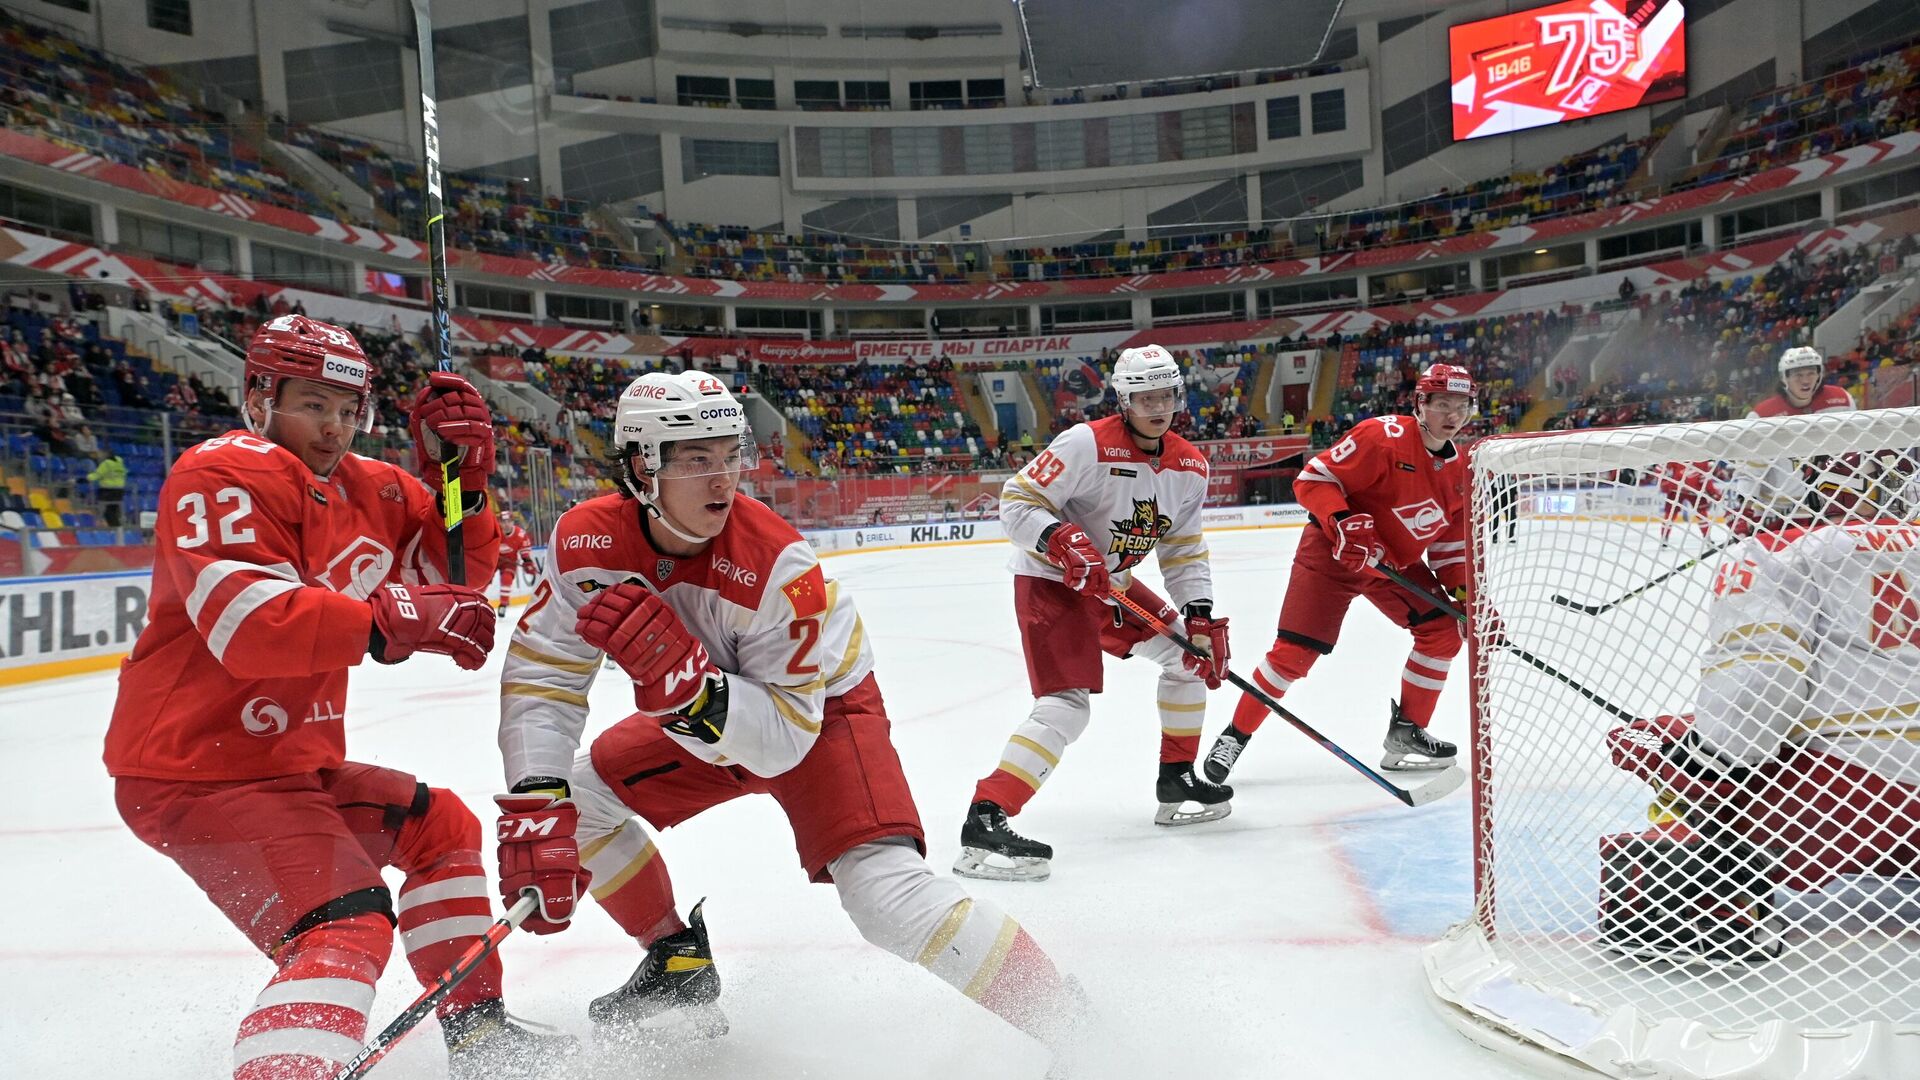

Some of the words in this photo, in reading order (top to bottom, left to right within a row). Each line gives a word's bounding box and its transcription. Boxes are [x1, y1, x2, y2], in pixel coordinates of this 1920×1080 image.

[1536, 12, 1627, 96] 75
[1488, 56, 1531, 83] 1946
[422, 93, 442, 200] CCM
[858, 343, 933, 357] ВМЕСТЕ
[941, 341, 975, 355] МЫ
[983, 336, 1071, 355] СПАРТАК
[1142, 350, 1160, 359] 93
[325, 361, 365, 379] согаз
[628, 384, 666, 400] vanke
[700, 408, 738, 420] согаз
[1103, 447, 1132, 459] vanke
[1026, 450, 1066, 489] 93
[1179, 457, 1206, 472] vanke
[176, 487, 256, 549] 32
[562, 534, 613, 551] vanke
[866, 533, 895, 543] ERIELL
[911, 524, 975, 543] KHL.RU
[710, 553, 758, 588] vanke
[785, 618, 821, 677] 2
[547, 895, 573, 904] CCM
